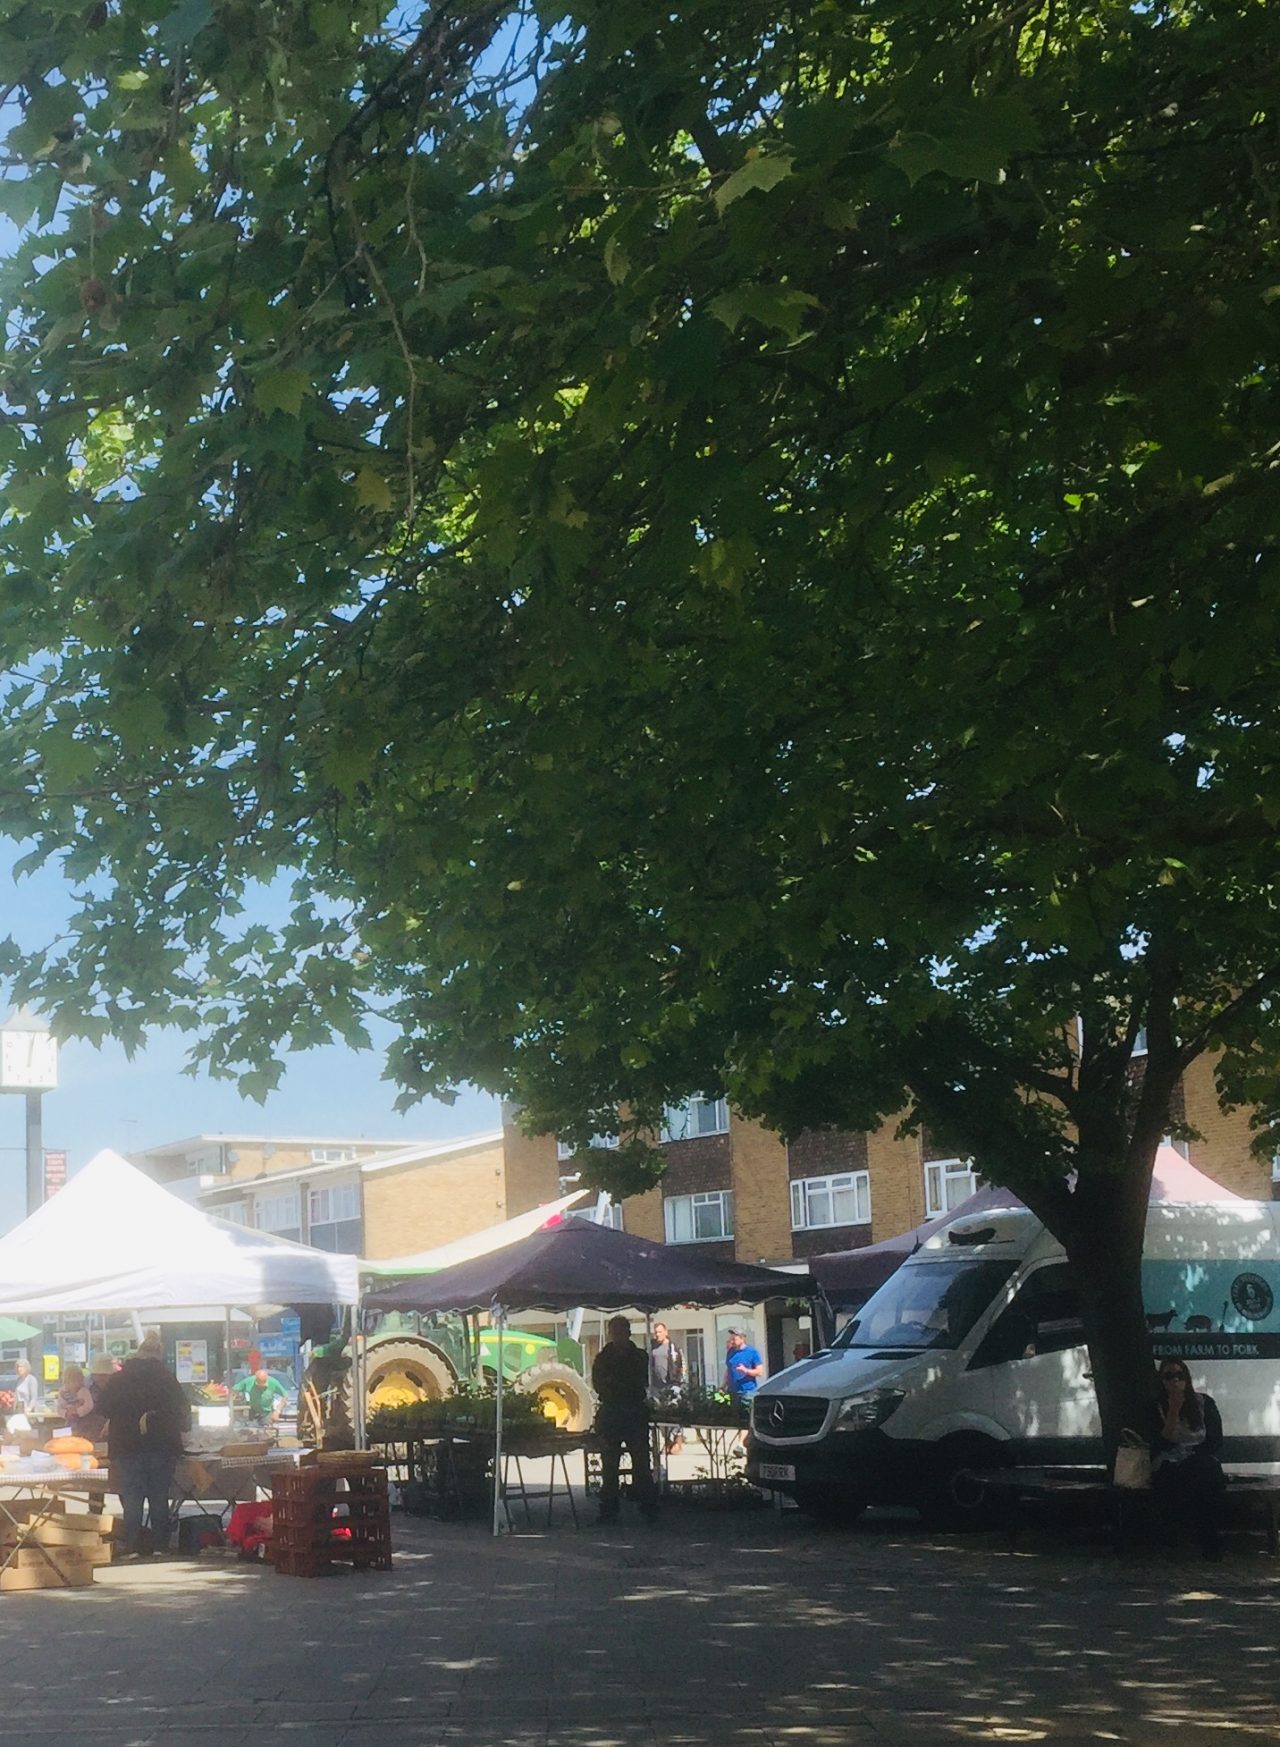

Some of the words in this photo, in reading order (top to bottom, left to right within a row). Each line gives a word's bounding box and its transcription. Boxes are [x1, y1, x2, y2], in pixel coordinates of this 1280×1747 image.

[1152, 1344, 1182, 1355] FROM
[1184, 1344, 1215, 1355] FARM
[1216, 1344, 1230, 1355] TO
[1232, 1344, 1260, 1355] FORK
